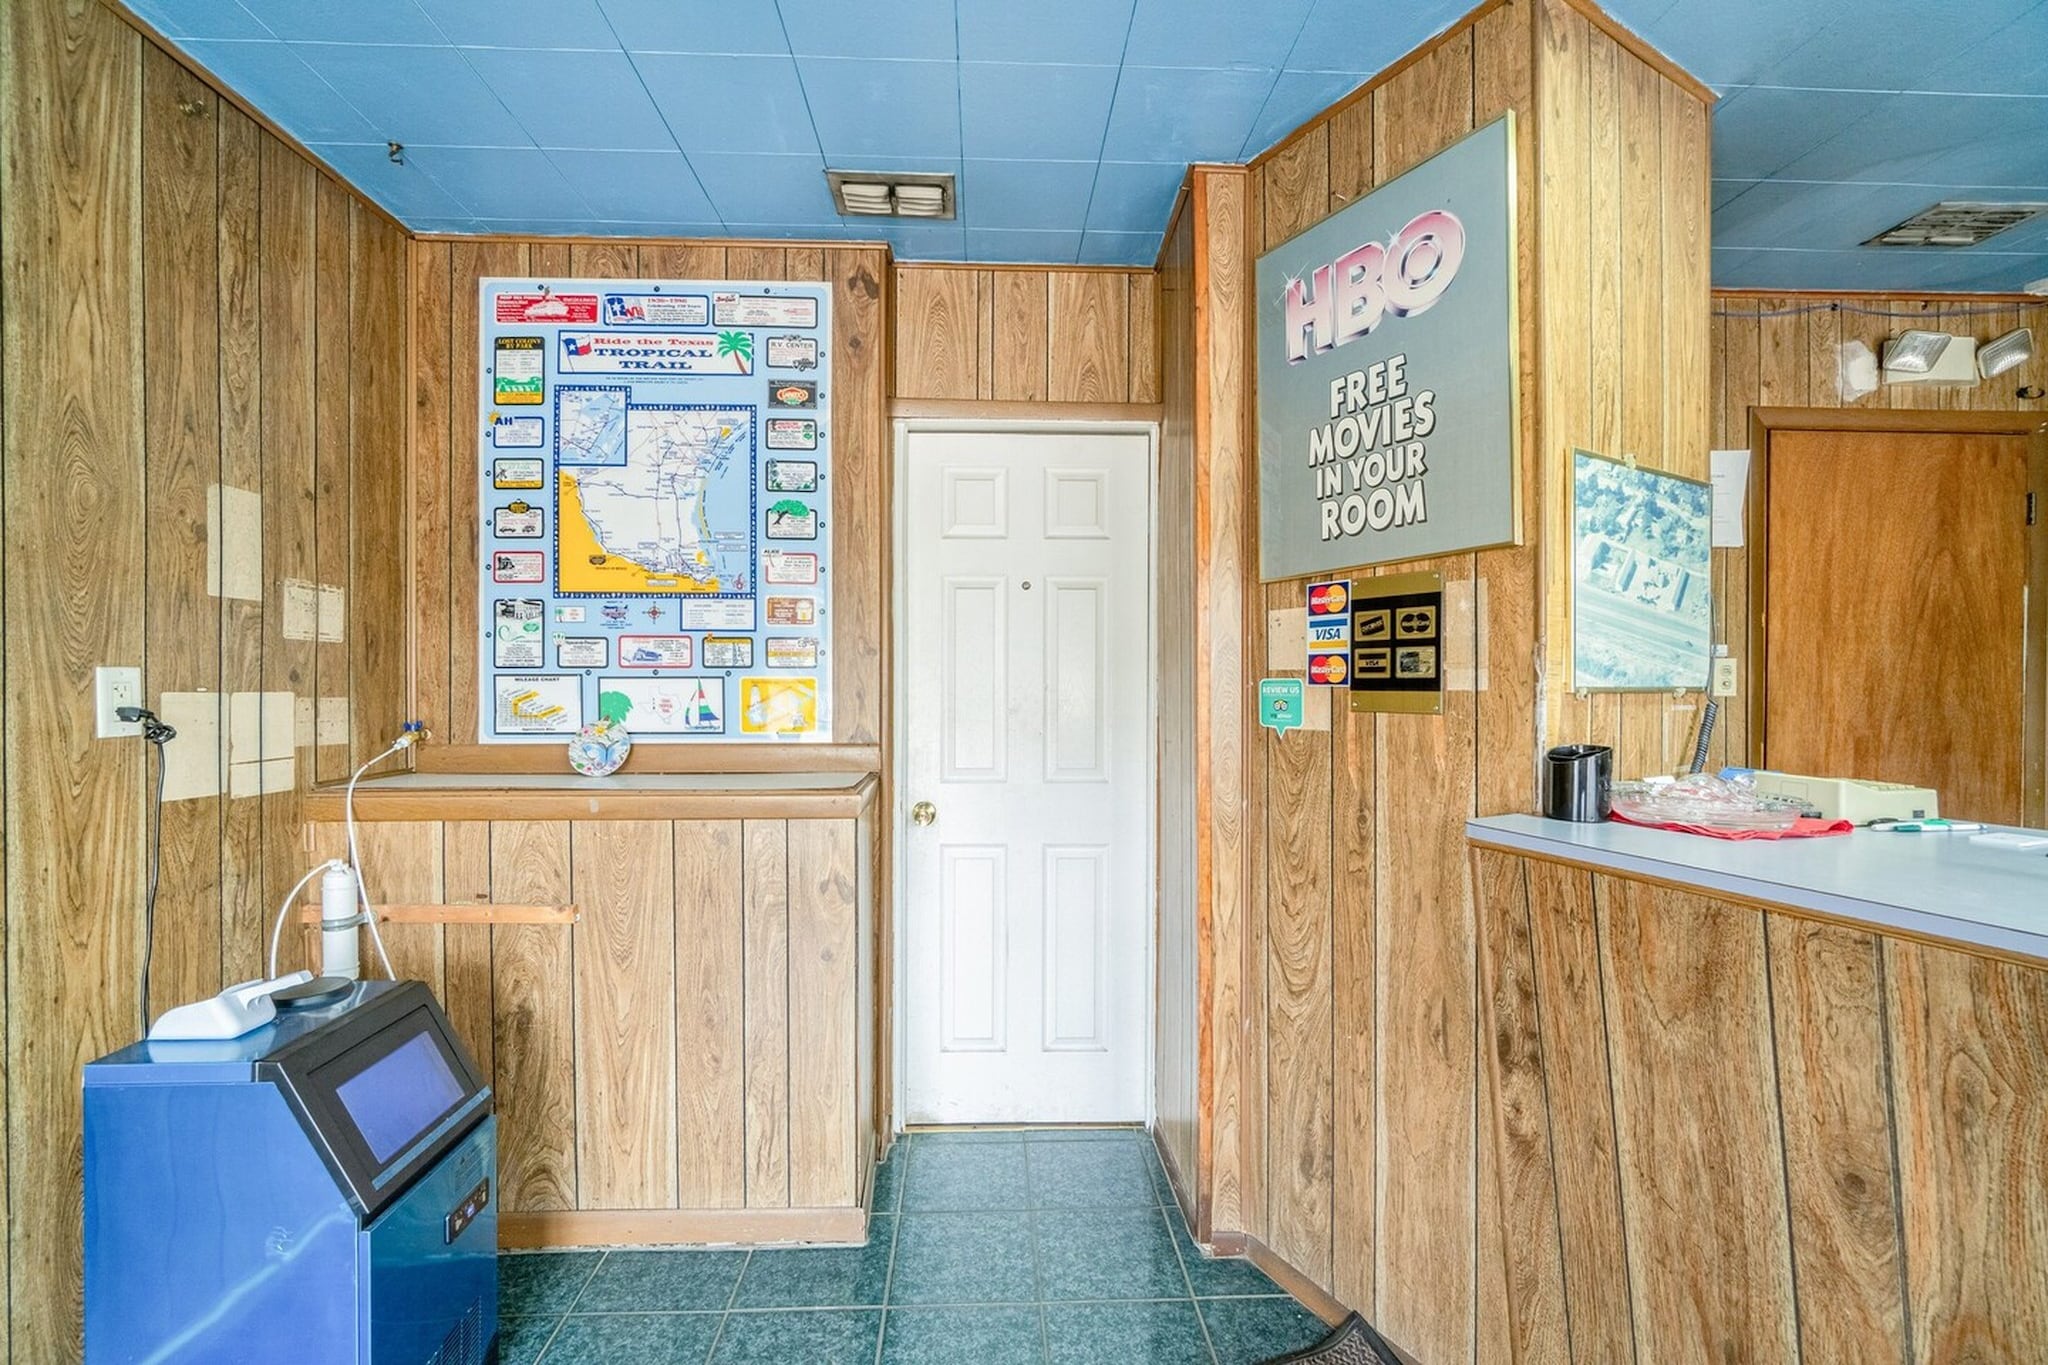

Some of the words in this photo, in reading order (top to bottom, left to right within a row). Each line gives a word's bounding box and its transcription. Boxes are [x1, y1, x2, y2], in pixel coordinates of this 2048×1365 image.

[1286, 210, 1466, 365] HBO
[594, 337, 628, 346] Ride
[636, 337, 663, 346] the
[668, 338, 714, 346] Texas
[594, 348, 713, 358] TROPICAL
[619, 359, 692, 370] TRAIL
[1330, 353, 1408, 420] FREE
[494, 416, 513, 426] AH
[1308, 389, 1436, 468] MOVIES
[1316, 465, 1344, 500] IN
[1349, 441, 1429, 493] YOUR
[1321, 479, 1428, 541] ROOM
[1315, 628, 1341, 641] VISA
[1262, 686, 1288, 694] REVIEW
[1289, 686, 1300, 694] US
